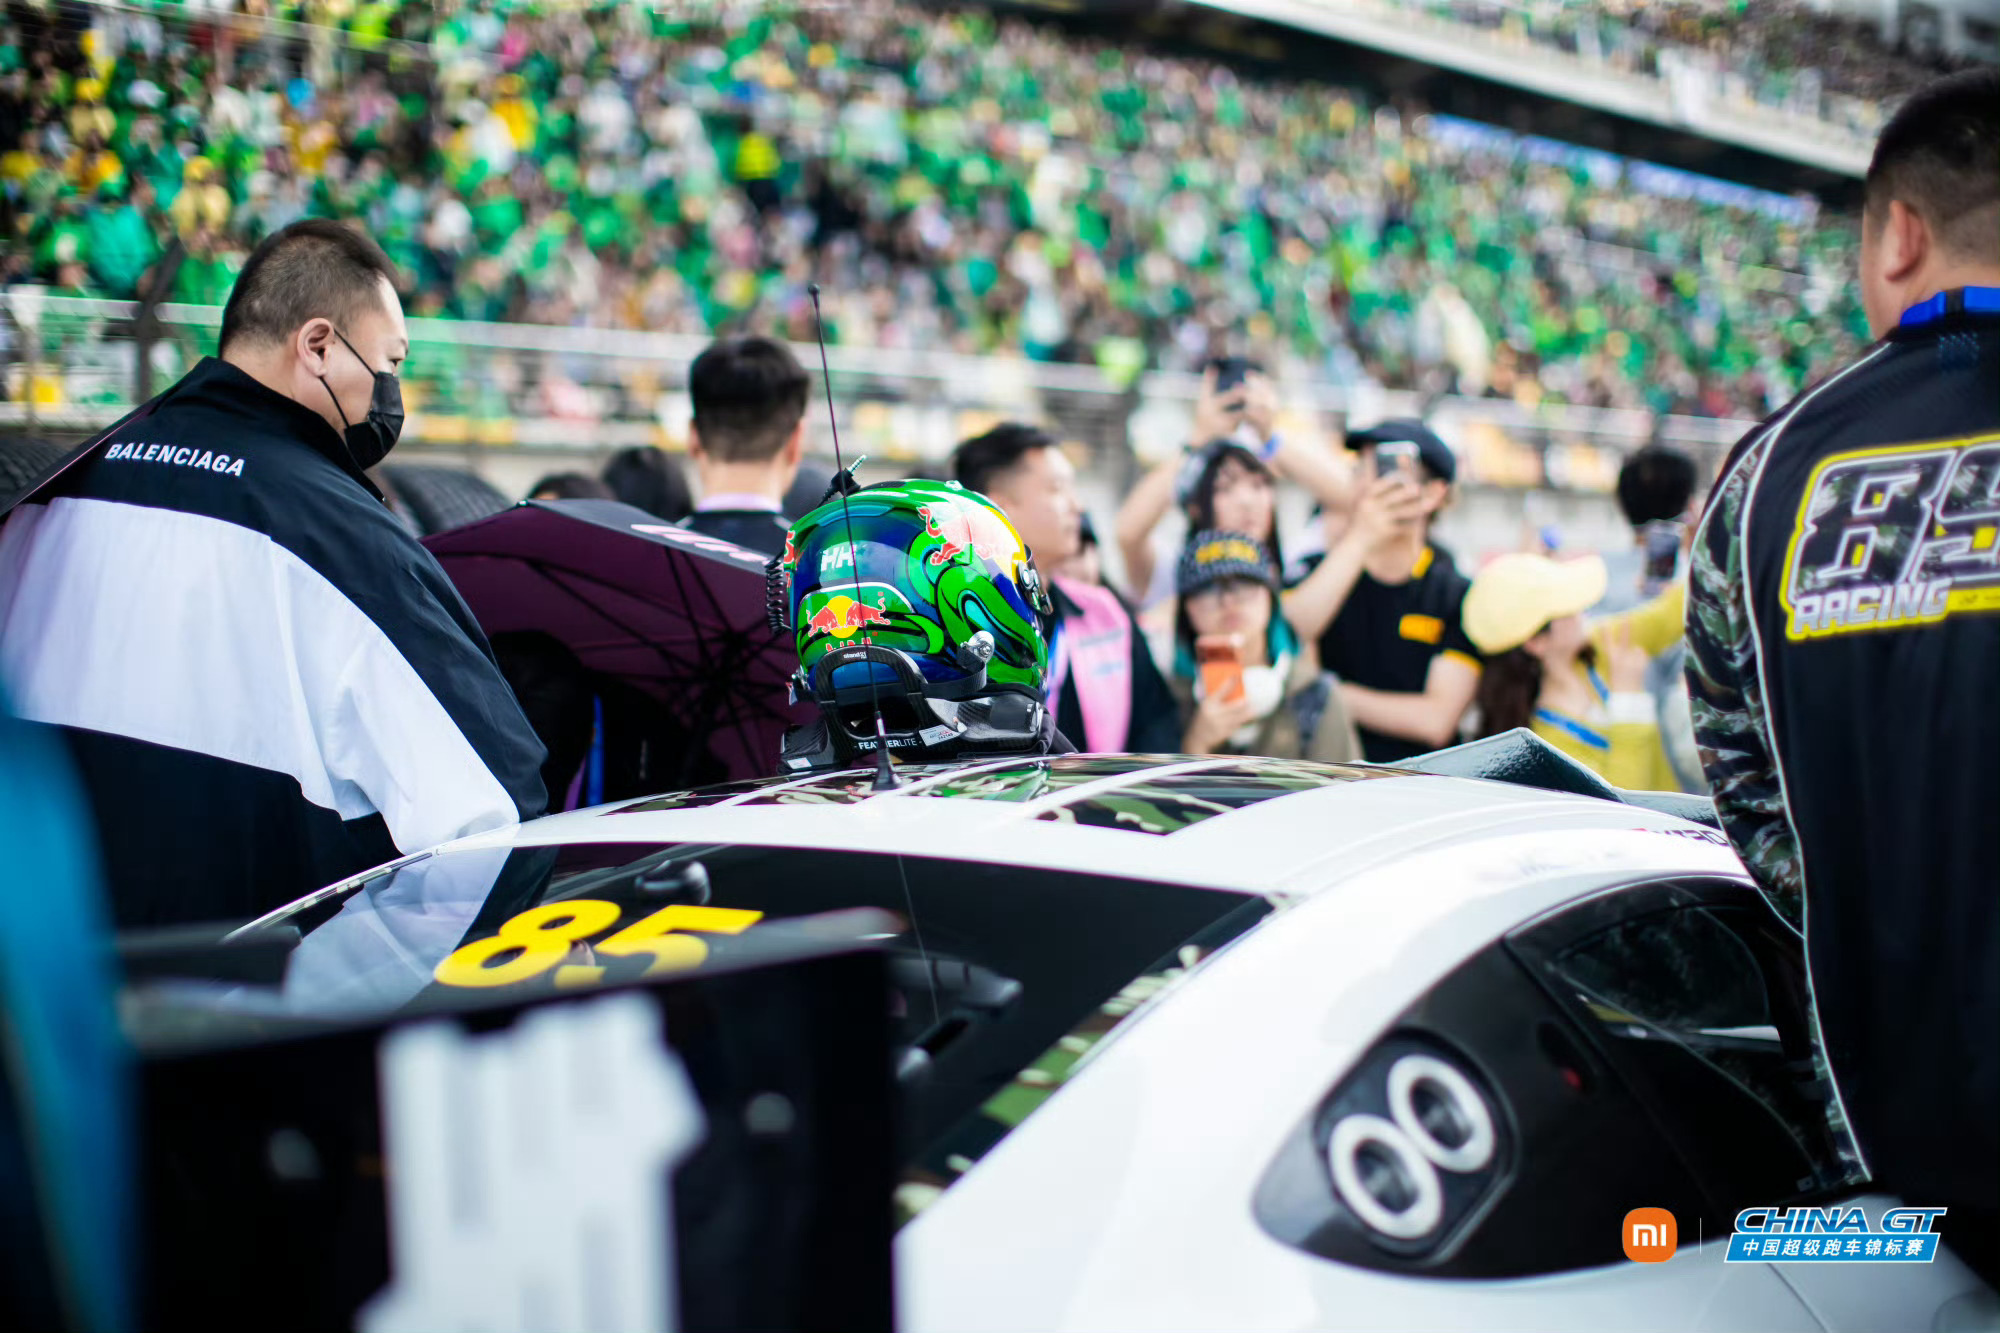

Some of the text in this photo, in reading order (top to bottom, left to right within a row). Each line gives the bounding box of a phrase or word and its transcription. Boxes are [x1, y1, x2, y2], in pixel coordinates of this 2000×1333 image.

[105, 443, 245, 477] BALENCIAGA
[1794, 579, 1953, 633] RACING
[858, 738, 918, 750] FEAERLITE
[434, 899, 764, 989] 85
